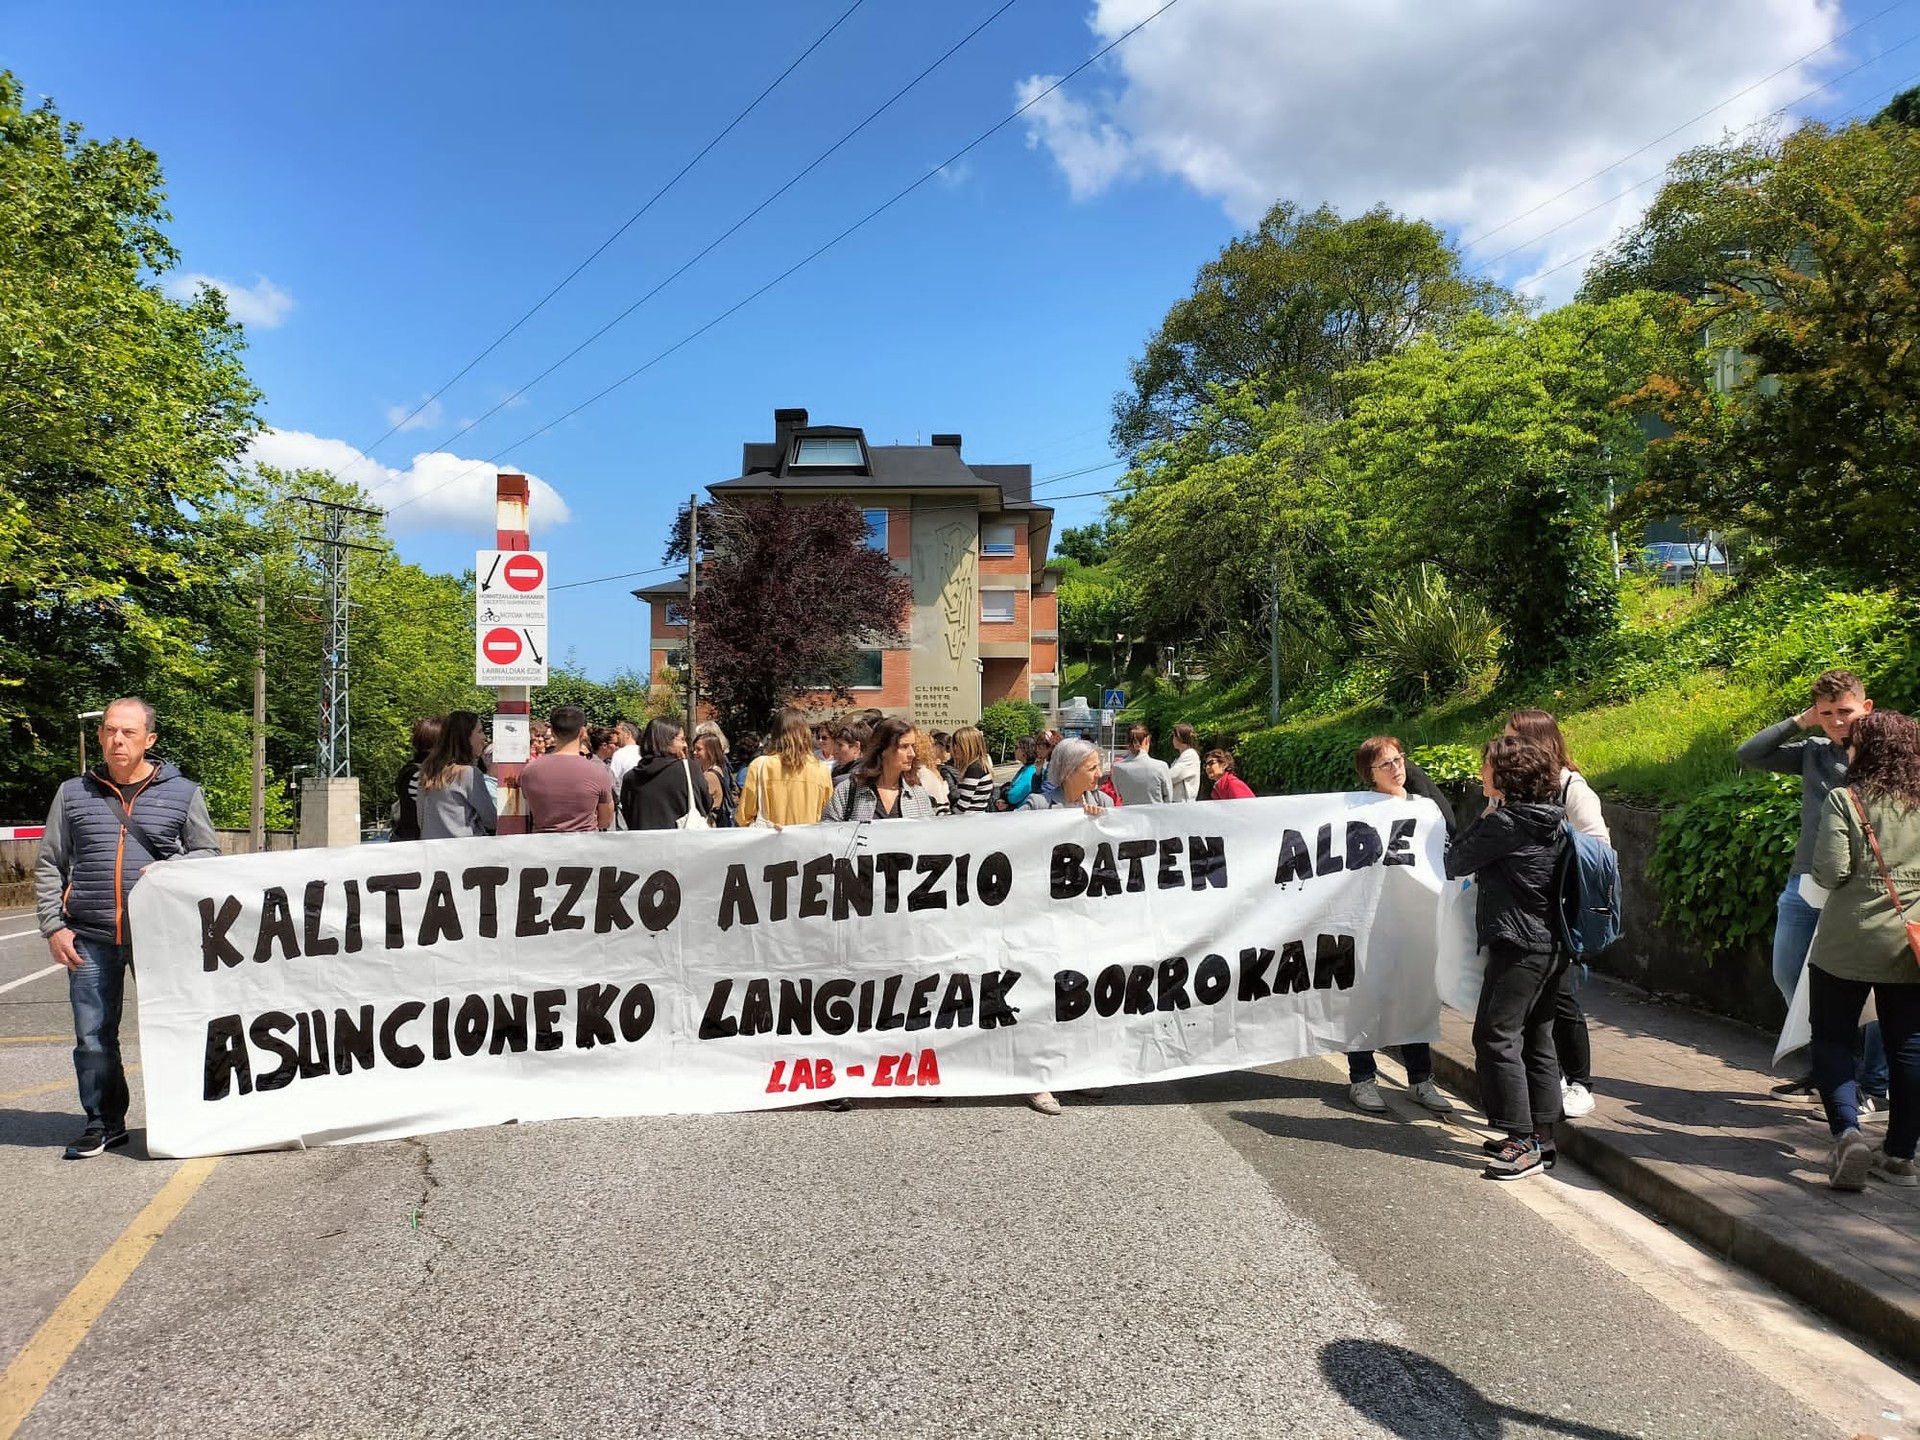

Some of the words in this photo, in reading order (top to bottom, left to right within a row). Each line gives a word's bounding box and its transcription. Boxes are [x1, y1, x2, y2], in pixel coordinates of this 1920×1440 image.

[482, 667, 525, 675] LARRIALDIAK
[197, 865, 682, 973] KALITATEZKO
[717, 850, 1013, 932] ATENTZIO
[1049, 836, 1228, 900] BATEN
[1275, 818, 1418, 887] ALDE
[203, 982, 656, 1102] ASUNCIONEKO
[698, 970, 1022, 1041] LANGILEAK
[1054, 933, 1356, 1023] BORROKAN
[765, 1058, 836, 1094] LAB
[871, 1047, 942, 1087] ELA
